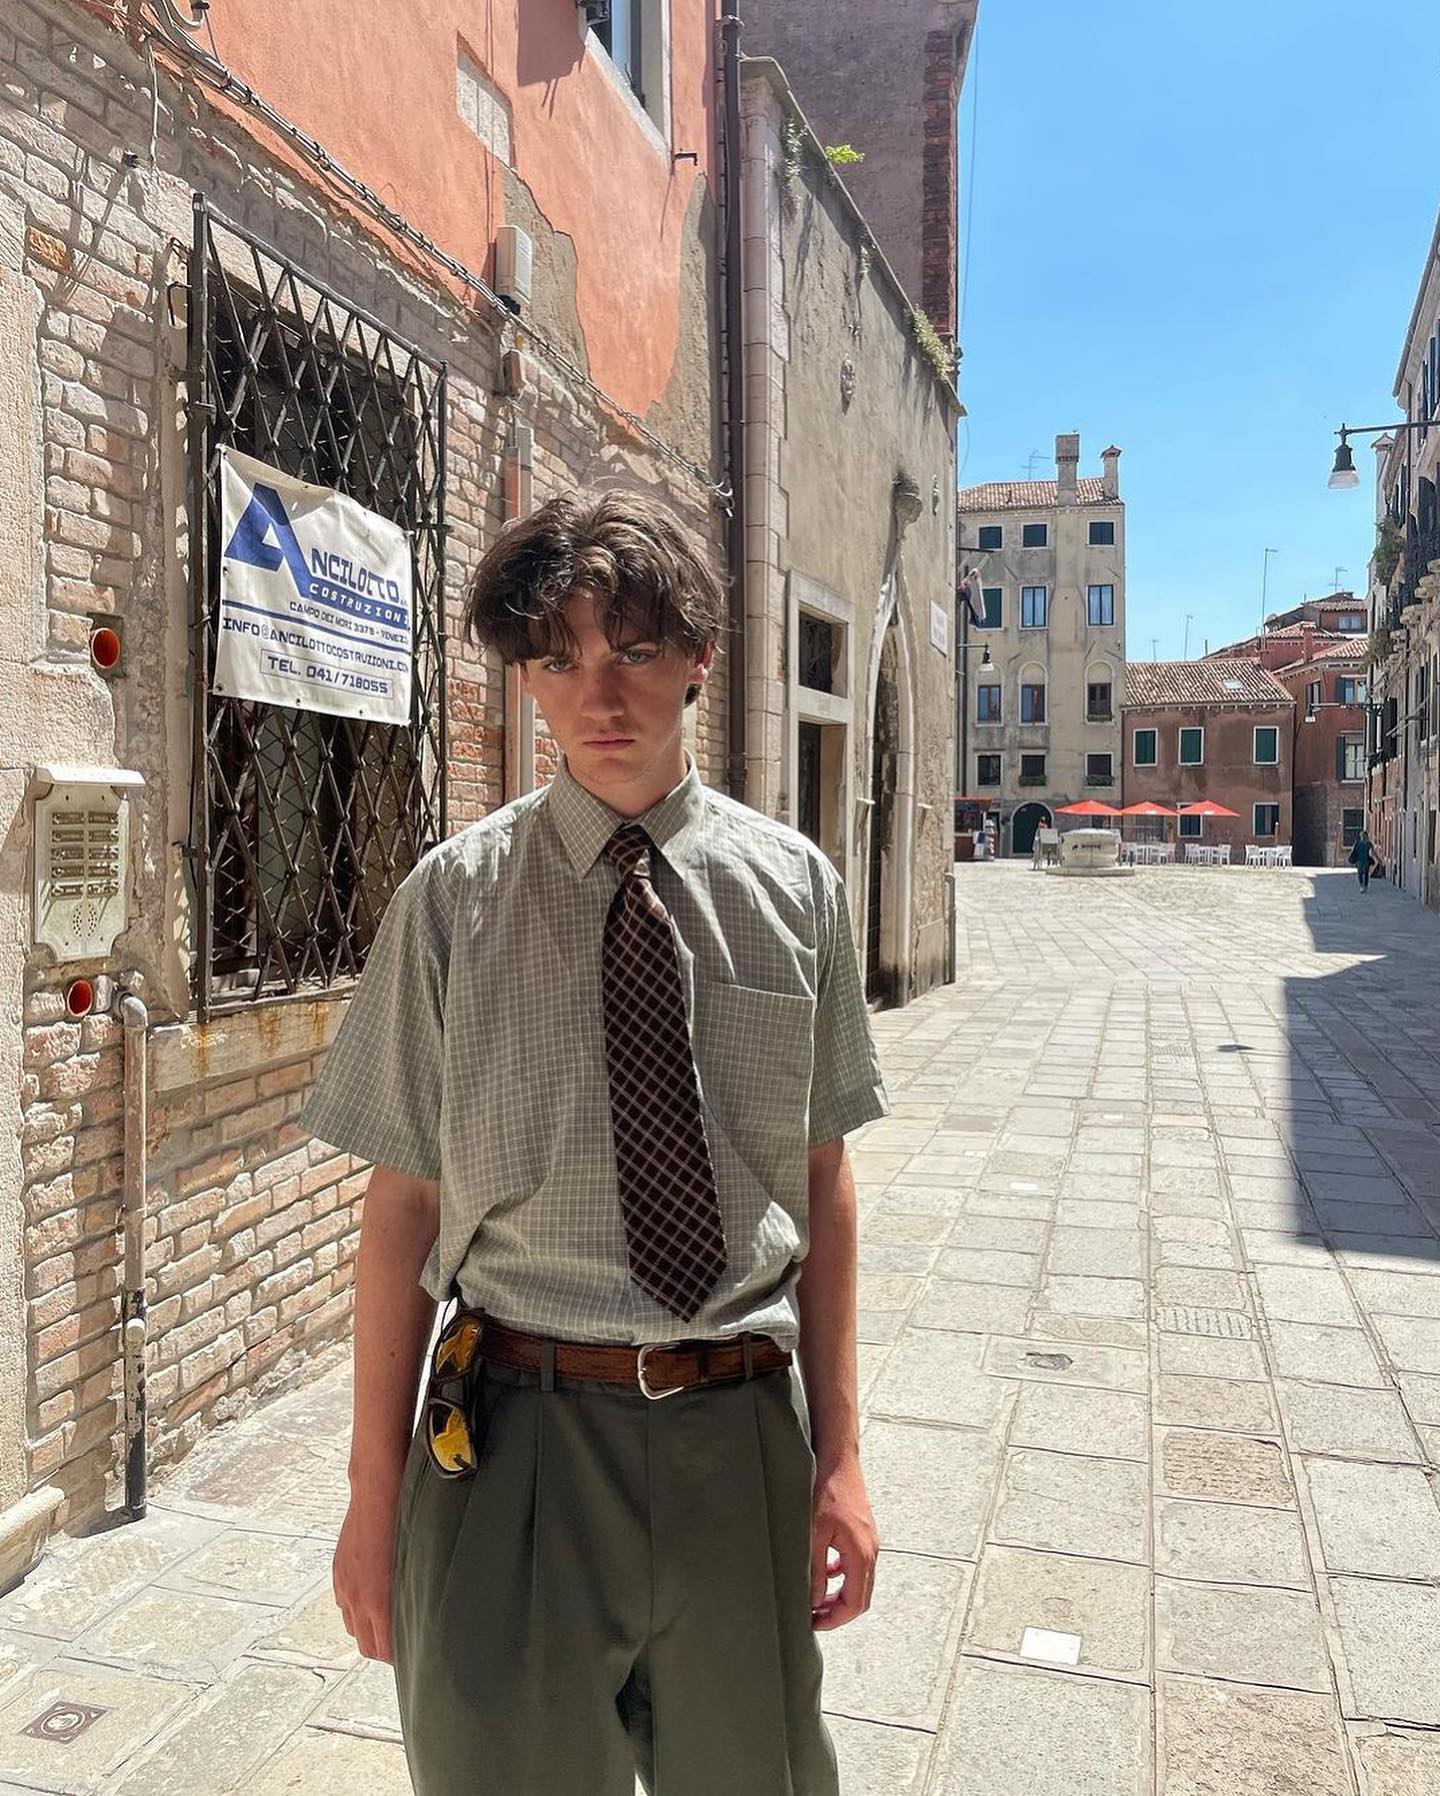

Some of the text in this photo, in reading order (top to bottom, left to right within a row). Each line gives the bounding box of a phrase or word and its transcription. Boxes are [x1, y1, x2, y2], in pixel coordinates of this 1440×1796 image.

[321, 611, 335, 624] DEI
[267, 655, 389, 693] TEL. 041/718055
